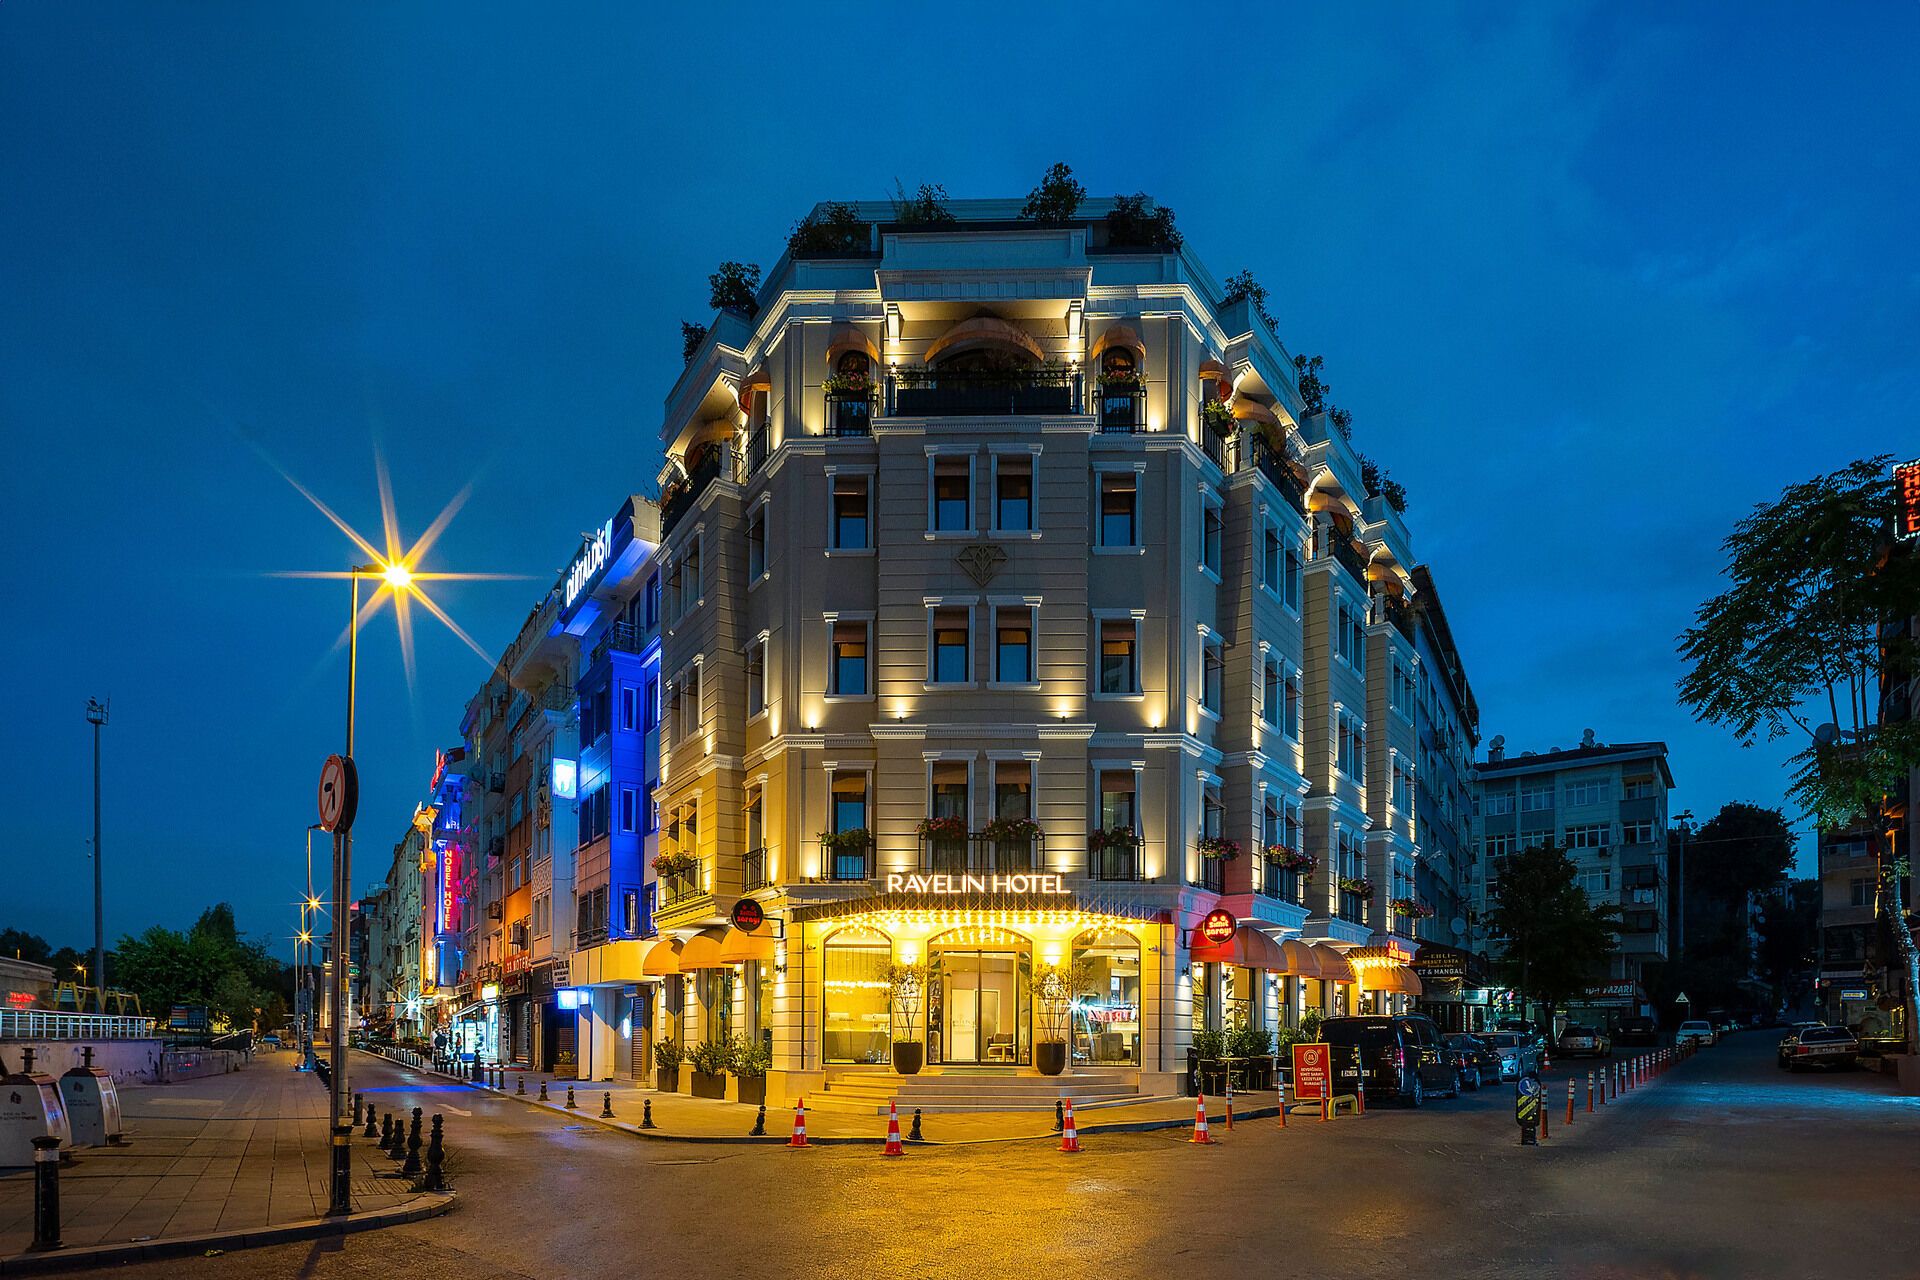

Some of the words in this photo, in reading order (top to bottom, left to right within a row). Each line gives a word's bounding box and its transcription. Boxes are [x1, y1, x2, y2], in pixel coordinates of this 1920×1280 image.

[444, 849, 452, 887] NOBEL
[887, 874, 985, 894] RAYELIN
[992, 874, 1072, 894] HOTEL
[444, 891, 452, 929] HOTEL
